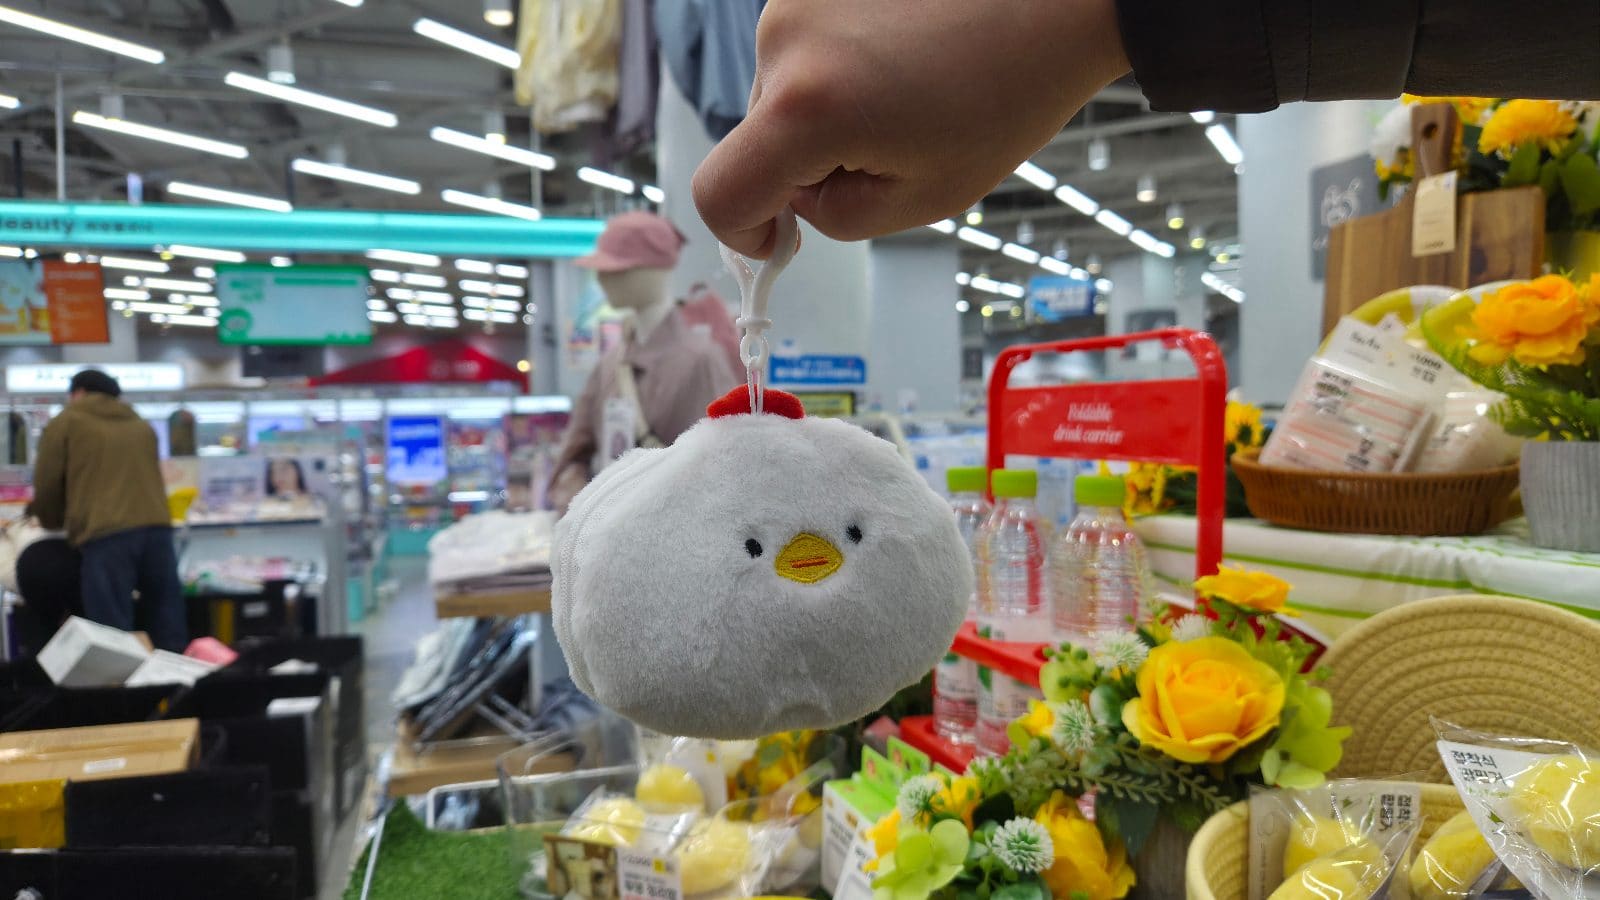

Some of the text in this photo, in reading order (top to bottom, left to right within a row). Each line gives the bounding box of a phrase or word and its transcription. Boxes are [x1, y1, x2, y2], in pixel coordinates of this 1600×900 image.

[0, 215, 74, 236] eauty
[1067, 402, 1114, 422] Foldable
[1053, 424, 1124, 445] drink carrier
